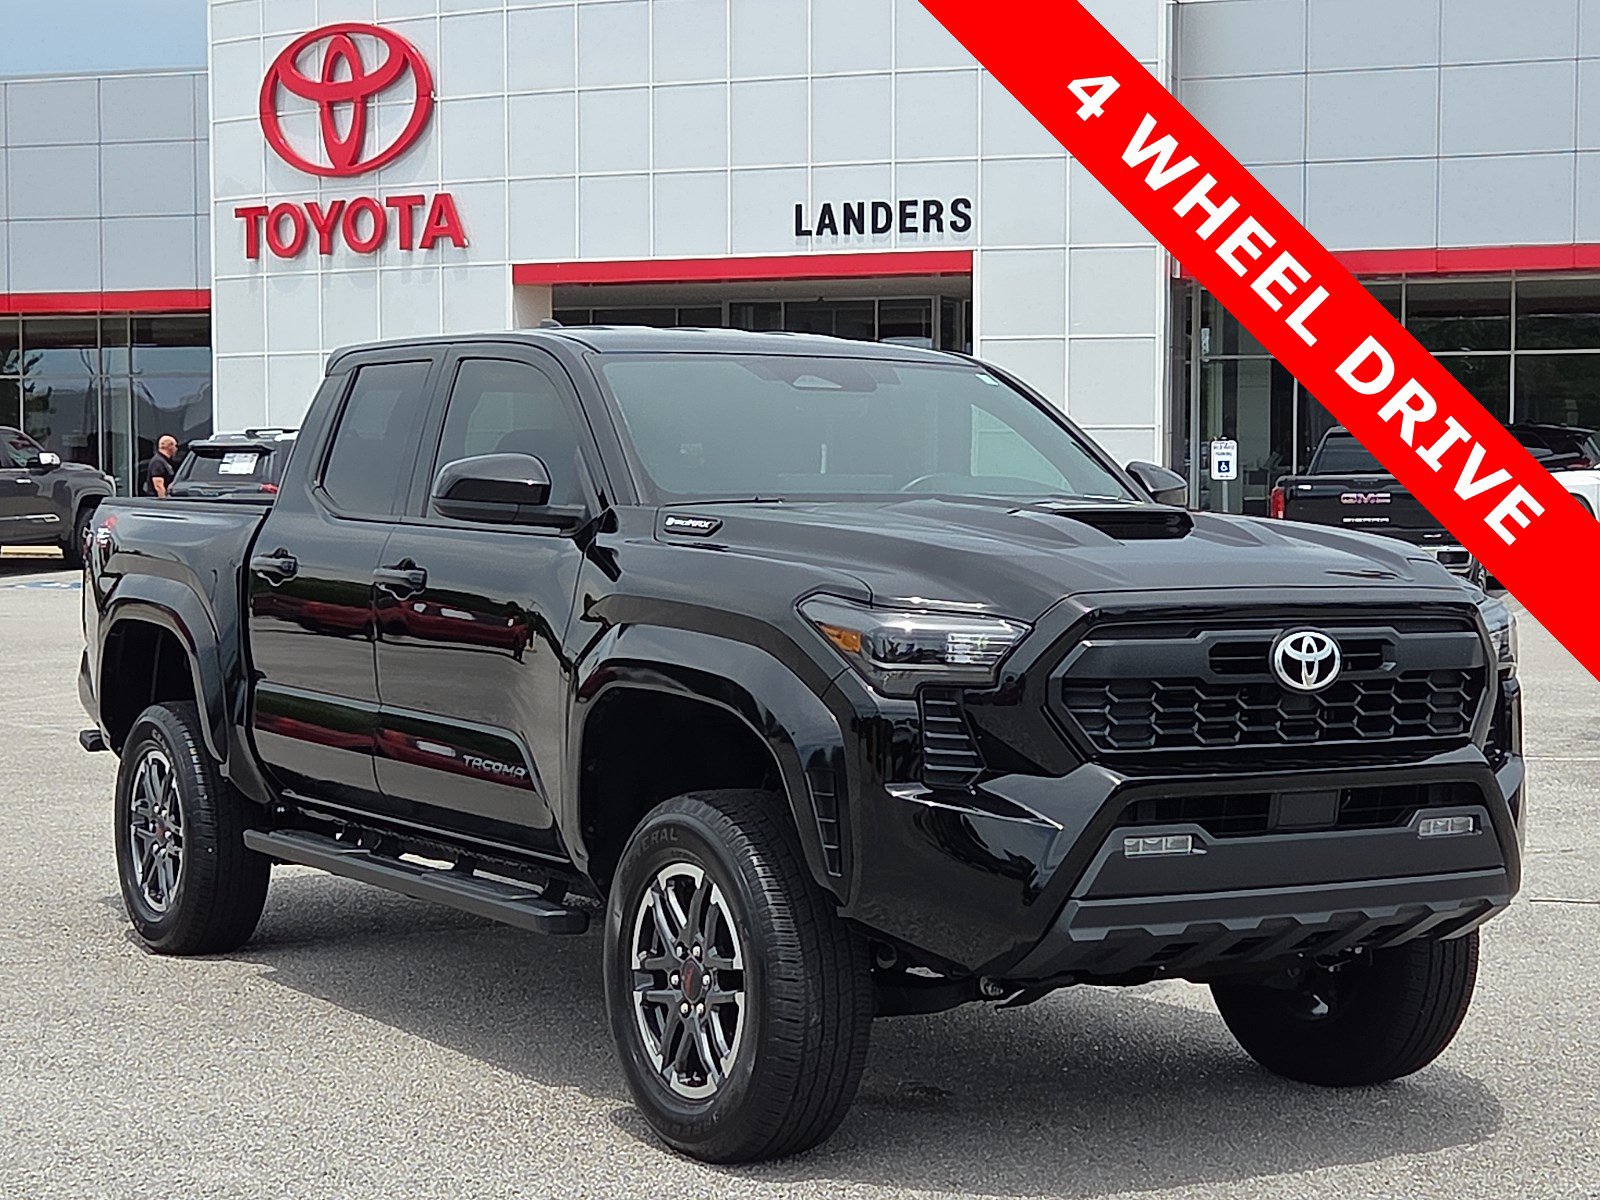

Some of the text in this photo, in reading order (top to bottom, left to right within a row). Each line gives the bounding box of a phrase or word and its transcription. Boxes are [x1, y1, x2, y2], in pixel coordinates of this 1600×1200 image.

[235, 193, 468, 259] TOYOTA
[795, 198, 972, 237] LANDERS
[1340, 492, 1391, 504] GMC
[462, 754, 526, 779] TACOMA
